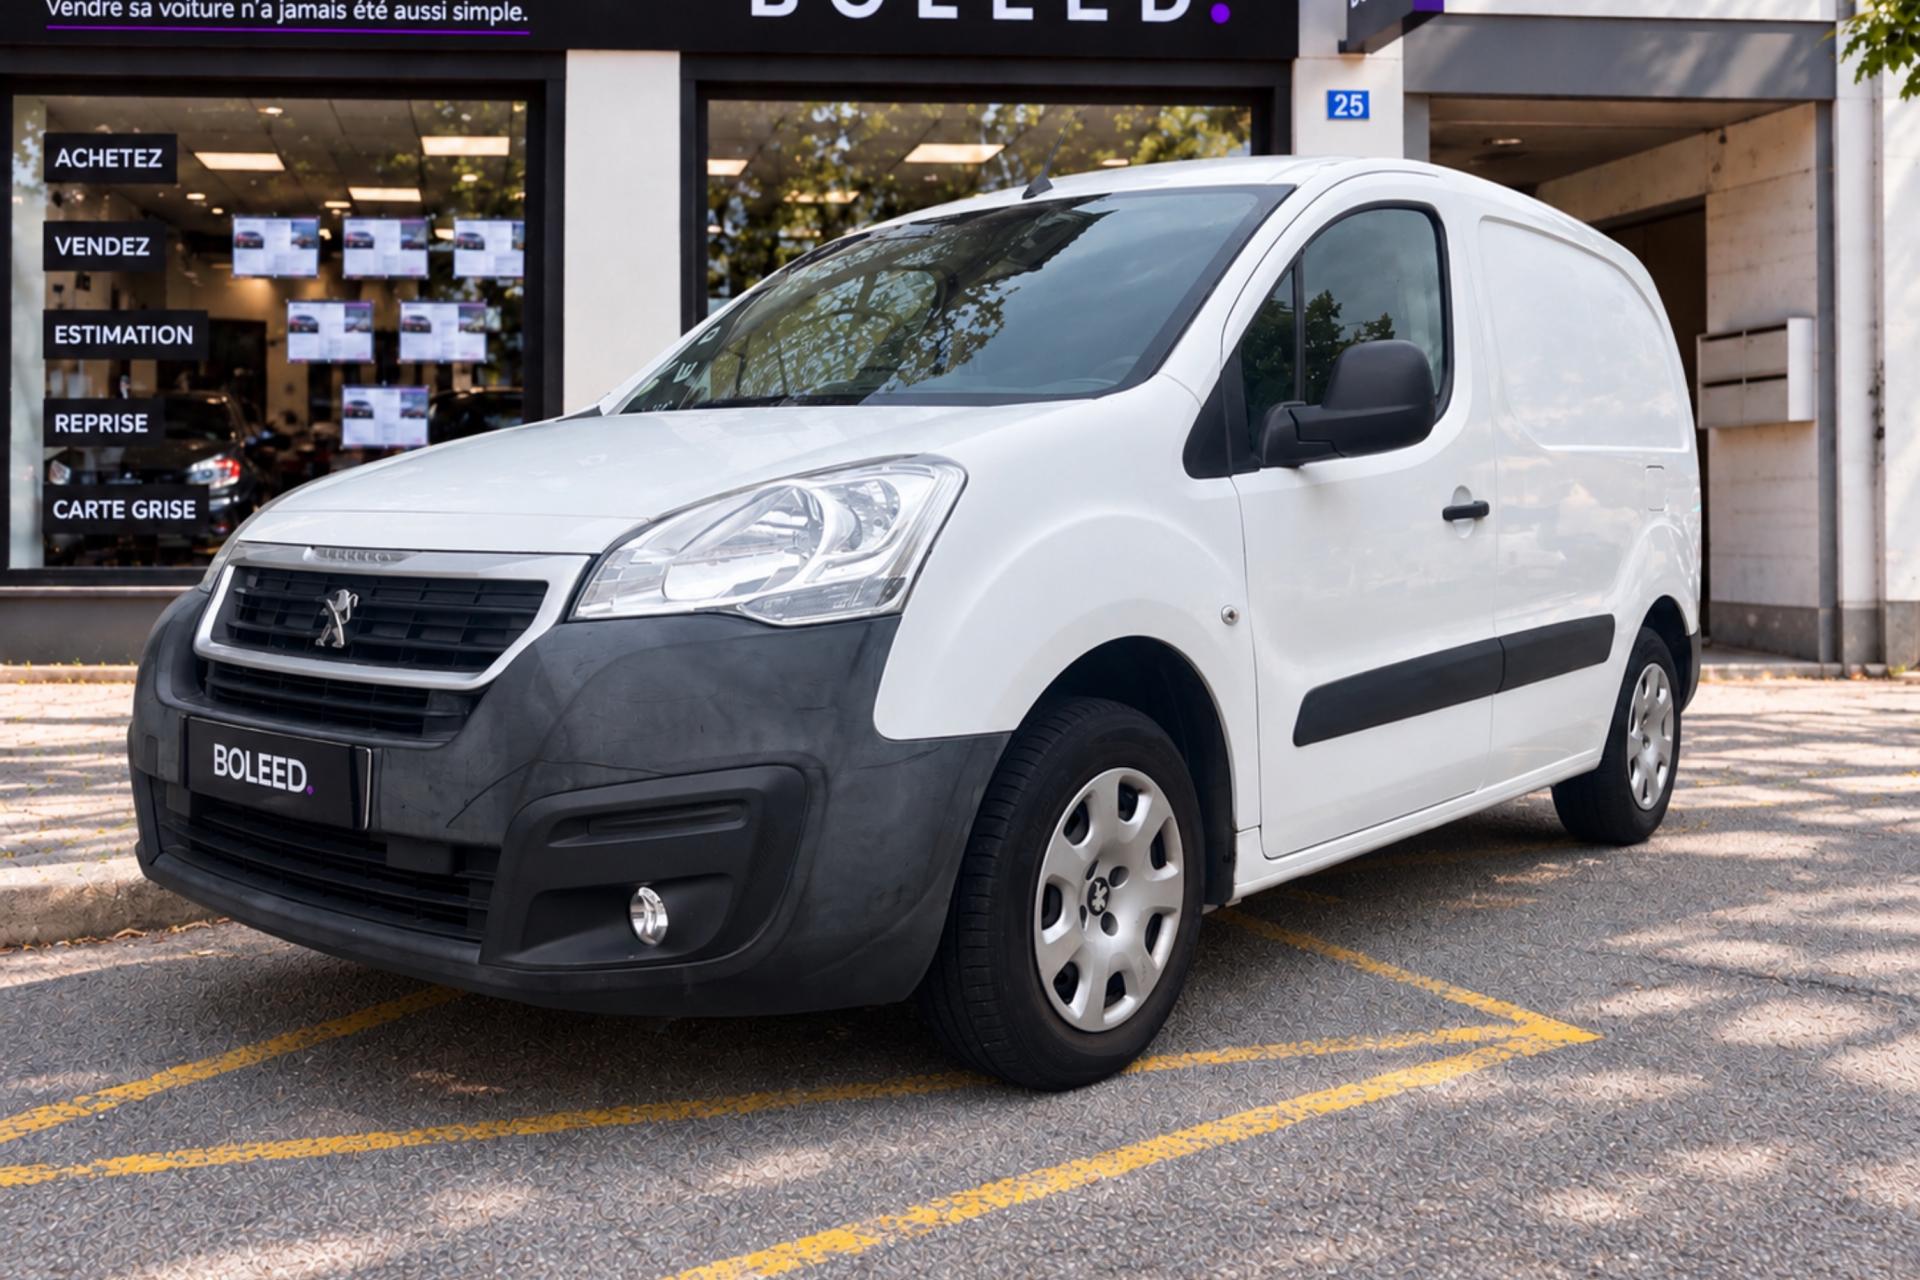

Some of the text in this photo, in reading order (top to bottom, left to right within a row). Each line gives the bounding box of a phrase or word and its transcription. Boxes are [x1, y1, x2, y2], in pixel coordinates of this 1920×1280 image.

[46, 0, 123, 17] Vendre
[129, 1, 152, 18] sa
[158, 0, 235, 19] voiture
[276, 0, 347, 25] jamais
[353, 0, 388, 20] été
[393, 0, 447, 21] aussi
[452, 0, 528, 26] simple.
[1334, 94, 1364, 117] 25
[54, 147, 163, 168] ACHETEZ
[54, 236, 150, 256] VENDEZ
[55, 324, 193, 345] ESTIMATION
[55, 413, 149, 434] REPRISE
[53, 499, 196, 520] CARTE GRISE
